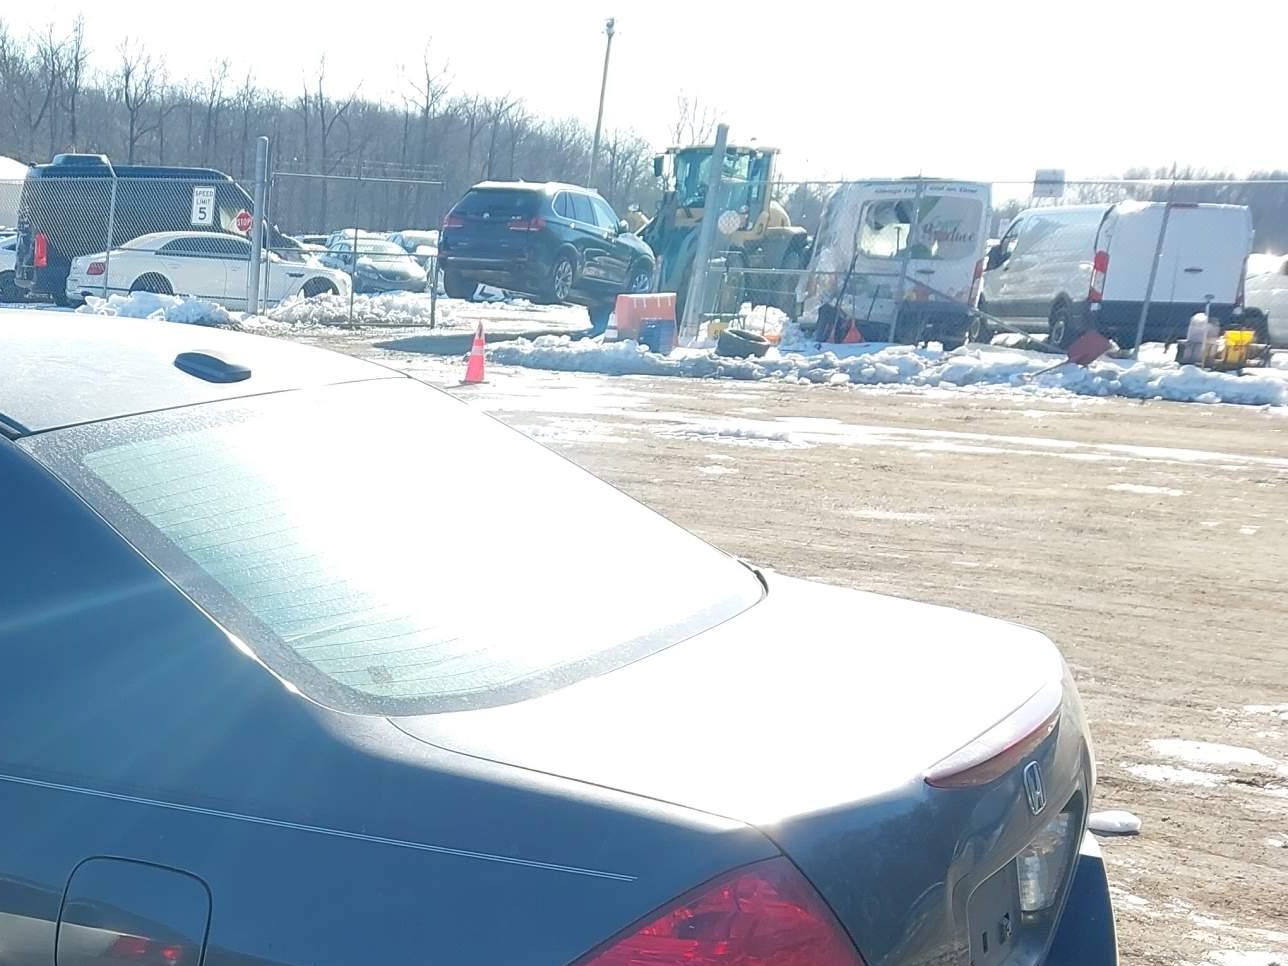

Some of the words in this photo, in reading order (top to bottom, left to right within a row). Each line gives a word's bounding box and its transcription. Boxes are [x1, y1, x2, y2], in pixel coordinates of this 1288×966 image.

[196, 198, 211, 206] LIMIT
[198, 207, 207, 220] 5
[237, 217, 252, 226] STOP
